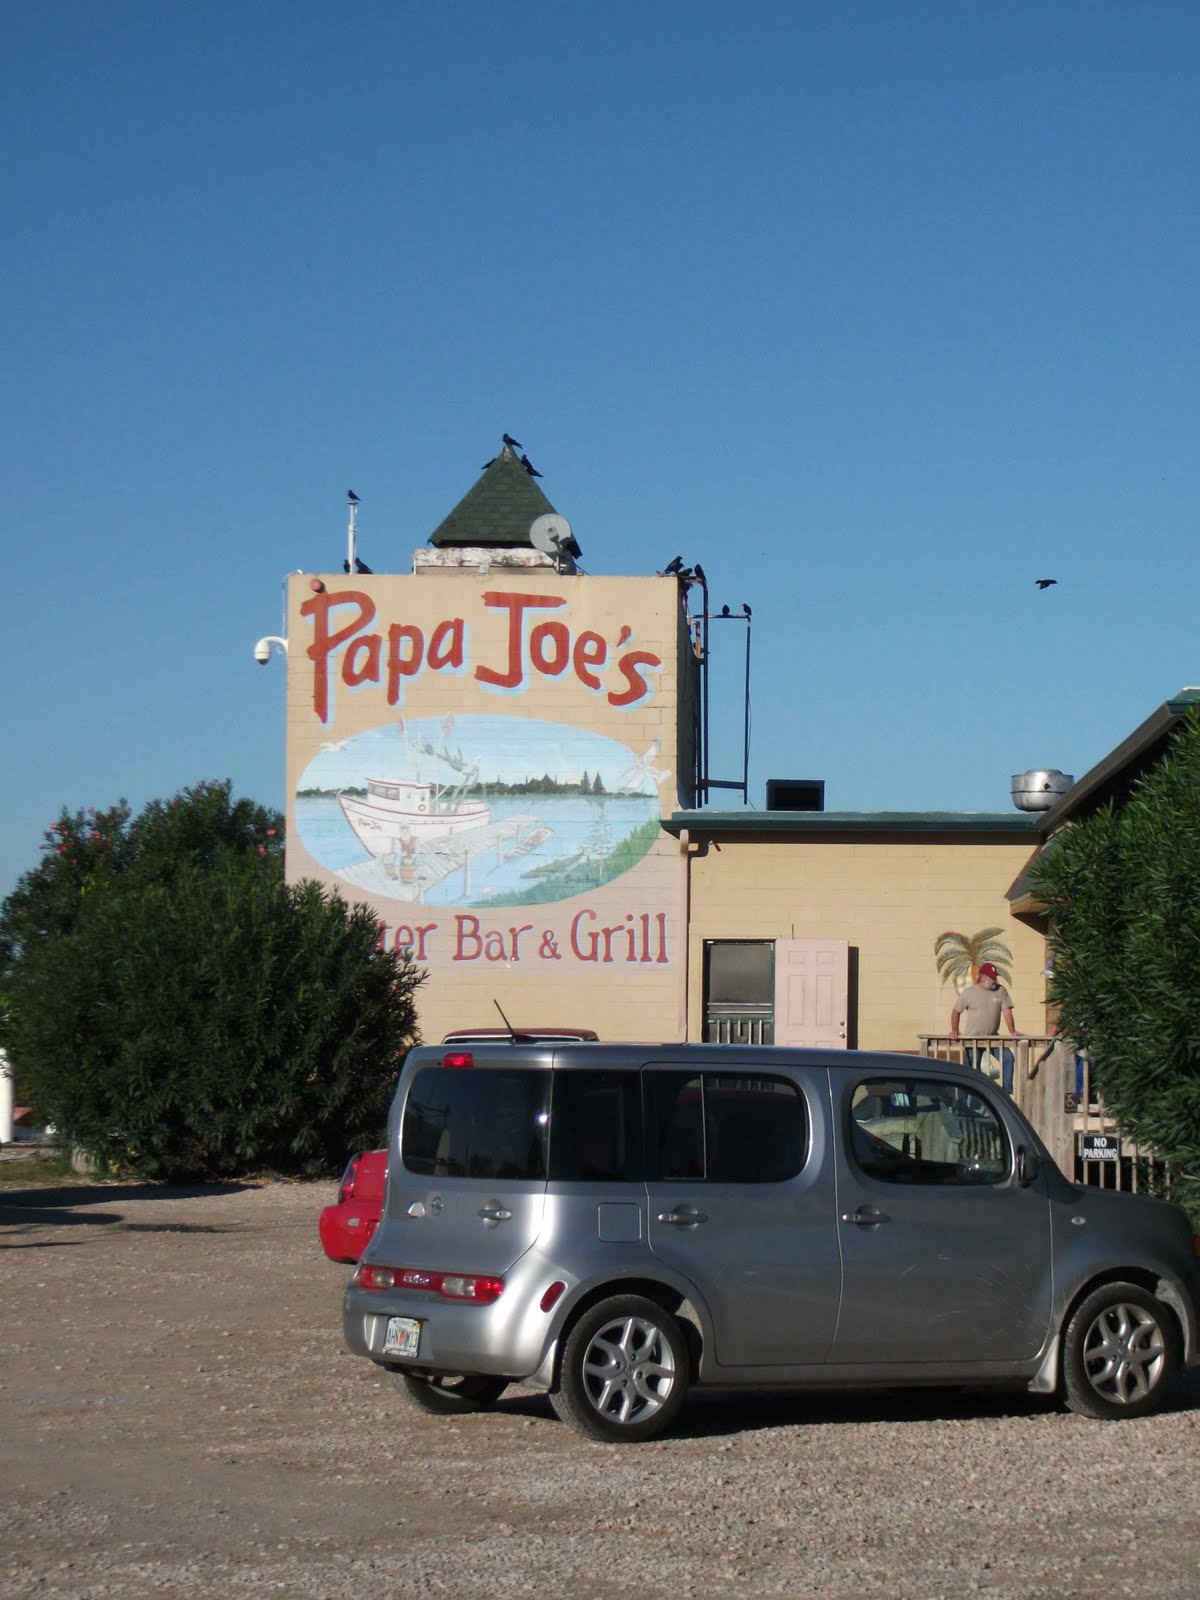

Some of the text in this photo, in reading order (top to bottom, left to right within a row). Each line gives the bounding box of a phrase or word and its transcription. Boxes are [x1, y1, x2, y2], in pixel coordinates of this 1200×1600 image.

[300, 590, 663, 724] Papa Joe's
[374, 908, 669, 963] ter Bar & Grill
[1083, 1148, 1117, 1158] PARKING
[1094, 1137, 1108, 1148] NO
